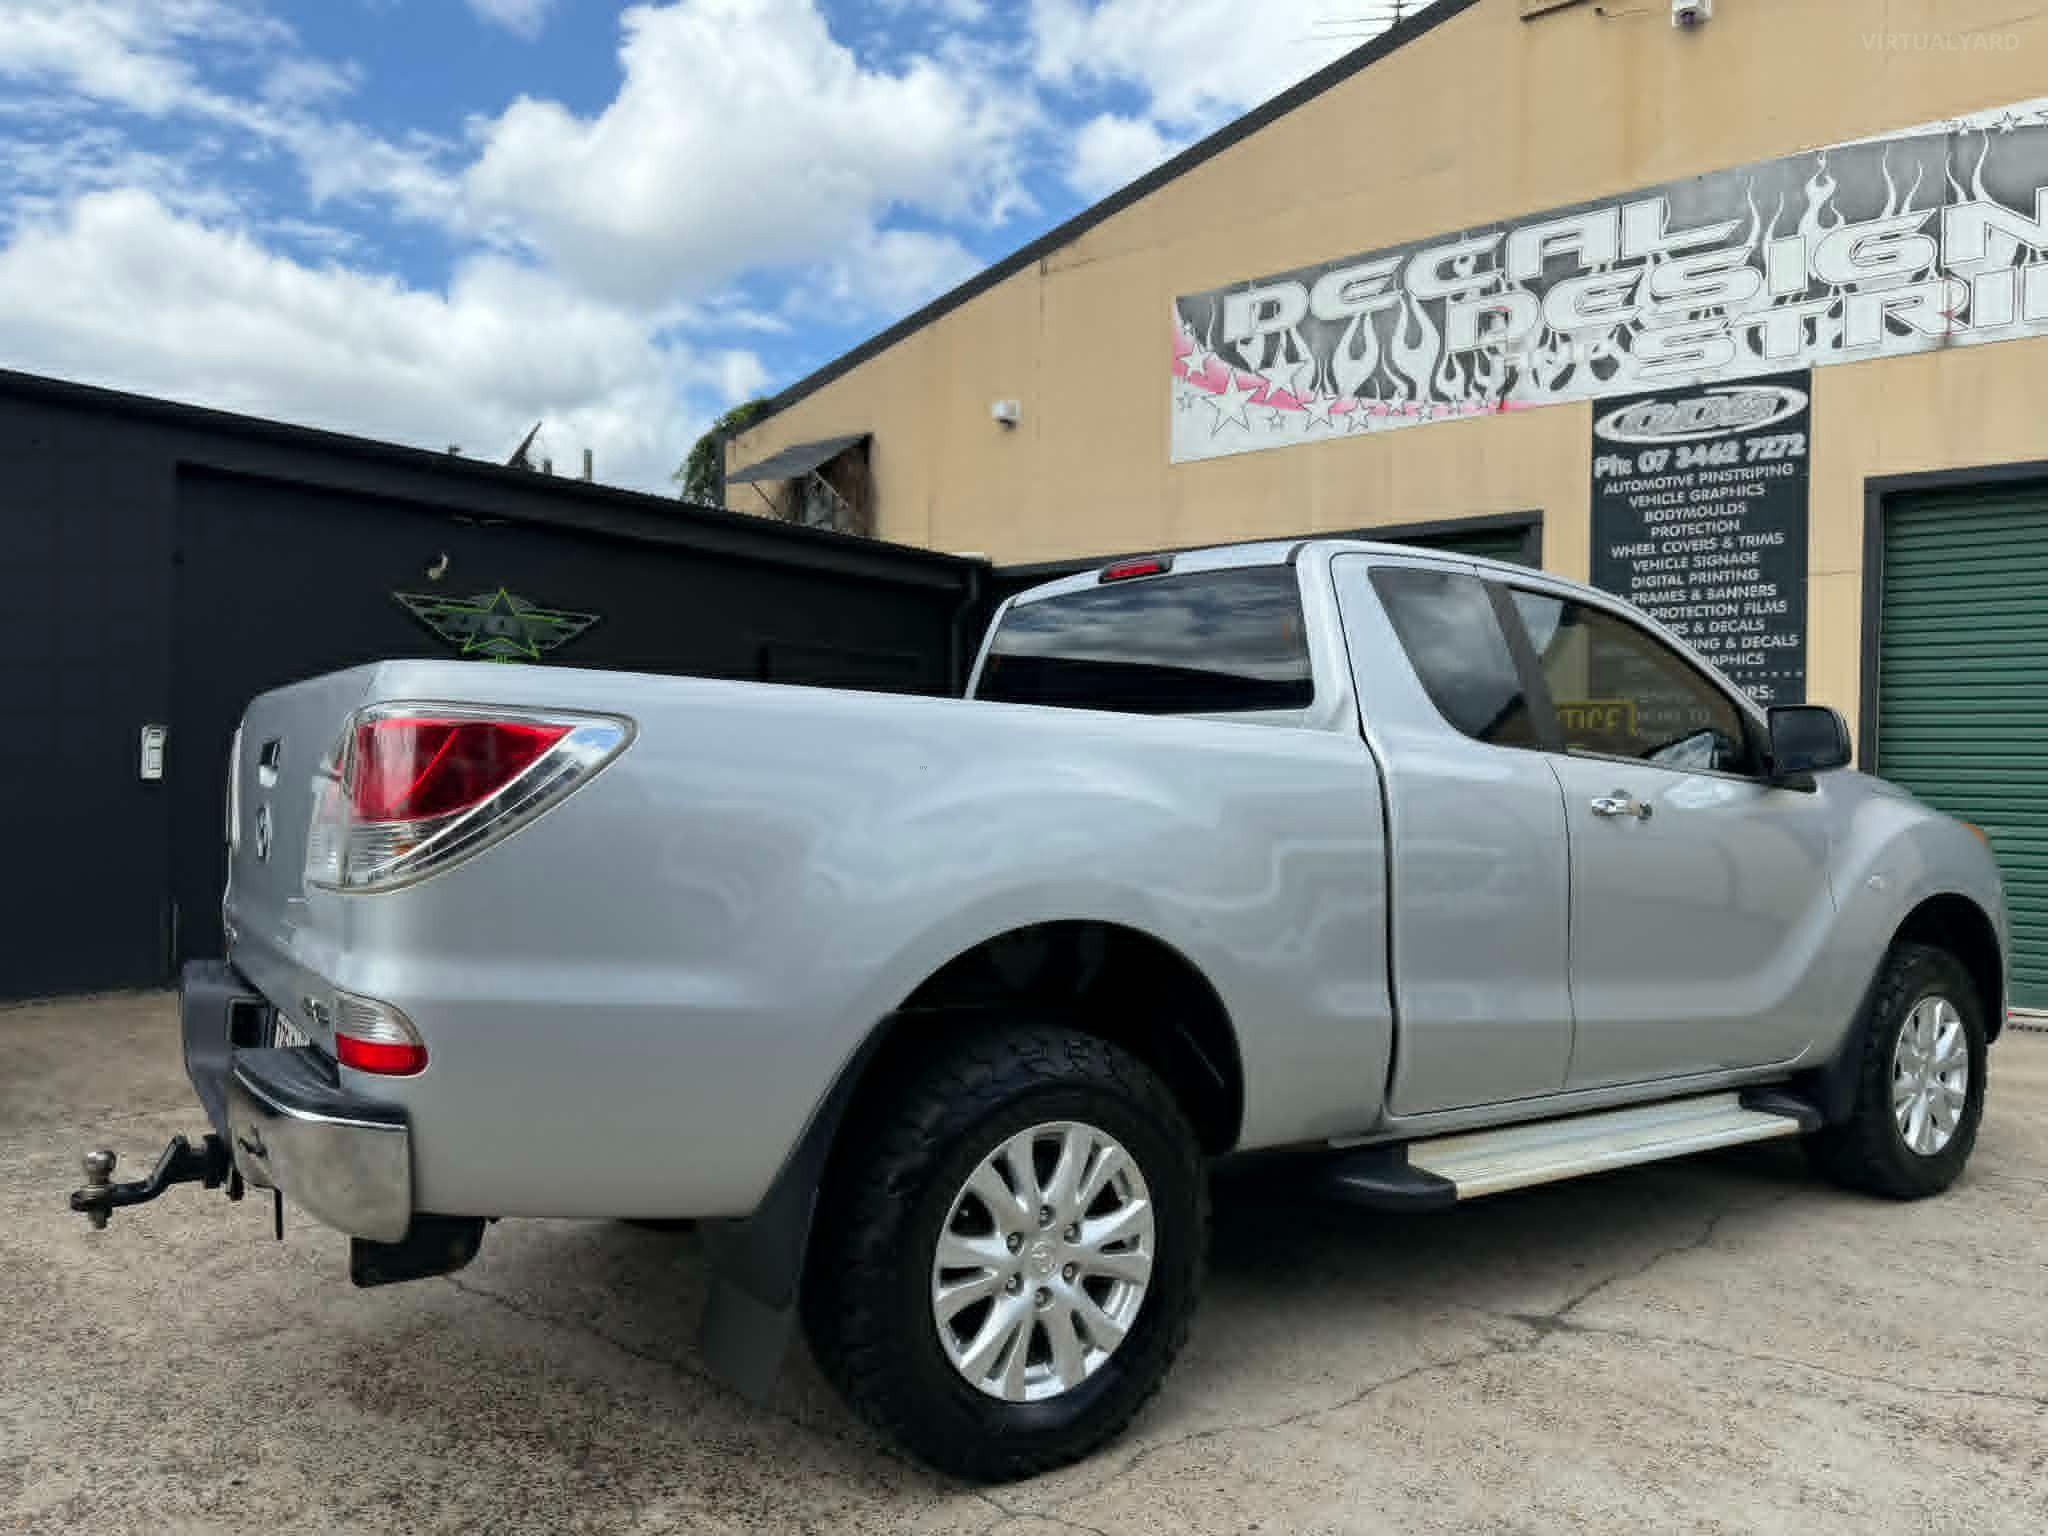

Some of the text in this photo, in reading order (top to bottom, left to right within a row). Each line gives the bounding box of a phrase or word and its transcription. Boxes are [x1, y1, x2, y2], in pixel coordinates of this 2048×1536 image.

[1223, 196, 1746, 345] DECAL
[1631, 260, 2048, 374] STRI
[1638, 449, 1671, 473] 07
[1745, 433, 1806, 462] 7272
[1604, 463, 1794, 495] AUTOMOTIVE PINSTRIPING
[1628, 483, 1766, 508] VEHICLE GRAPHICS
[1644, 501, 1747, 523] BODYMOULDS
[1651, 519, 1740, 537] PROTECTION
[1611, 532, 1785, 559] WHEEL COVERS & TRIMS
[1632, 552, 1760, 572] VEHICLE SIGNAGE
[1632, 568, 1760, 589] DIGITAL PRINTING
[1632, 590, 1686, 605] FRAMES
[1707, 584, 1777, 600] BANNERS
[1649, 600, 1787, 619] PROTECTION FILMS
[1693, 621, 1704, 635] &
[1709, 618, 1765, 634] DECALS
[1725, 636, 1736, 649] &
[1741, 634, 1800, 648] DECALS
